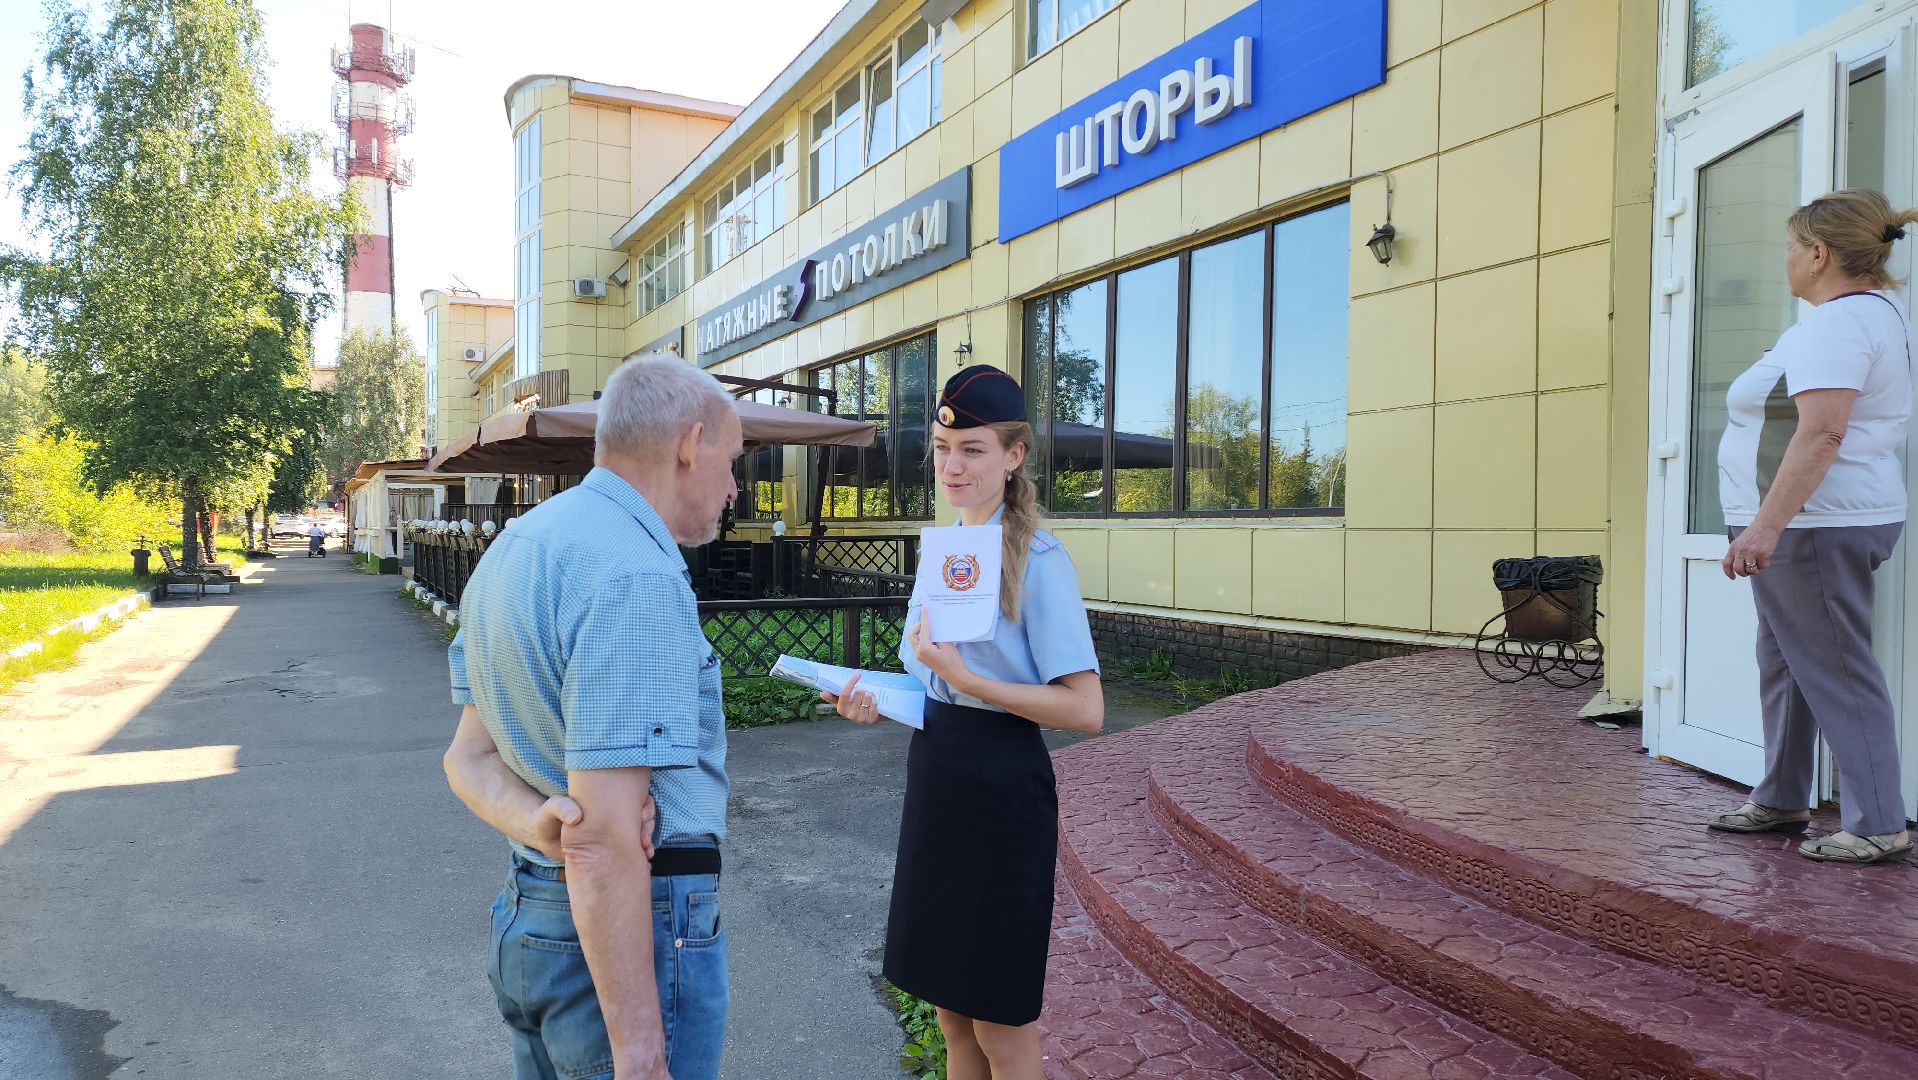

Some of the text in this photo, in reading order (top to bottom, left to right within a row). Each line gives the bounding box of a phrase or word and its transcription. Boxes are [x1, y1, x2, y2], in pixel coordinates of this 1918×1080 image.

[1056, 35, 1252, 189] ШТОРЫ
[697, 199, 948, 355] НАТЯЖНЫЕ ПОТОЛКИ
